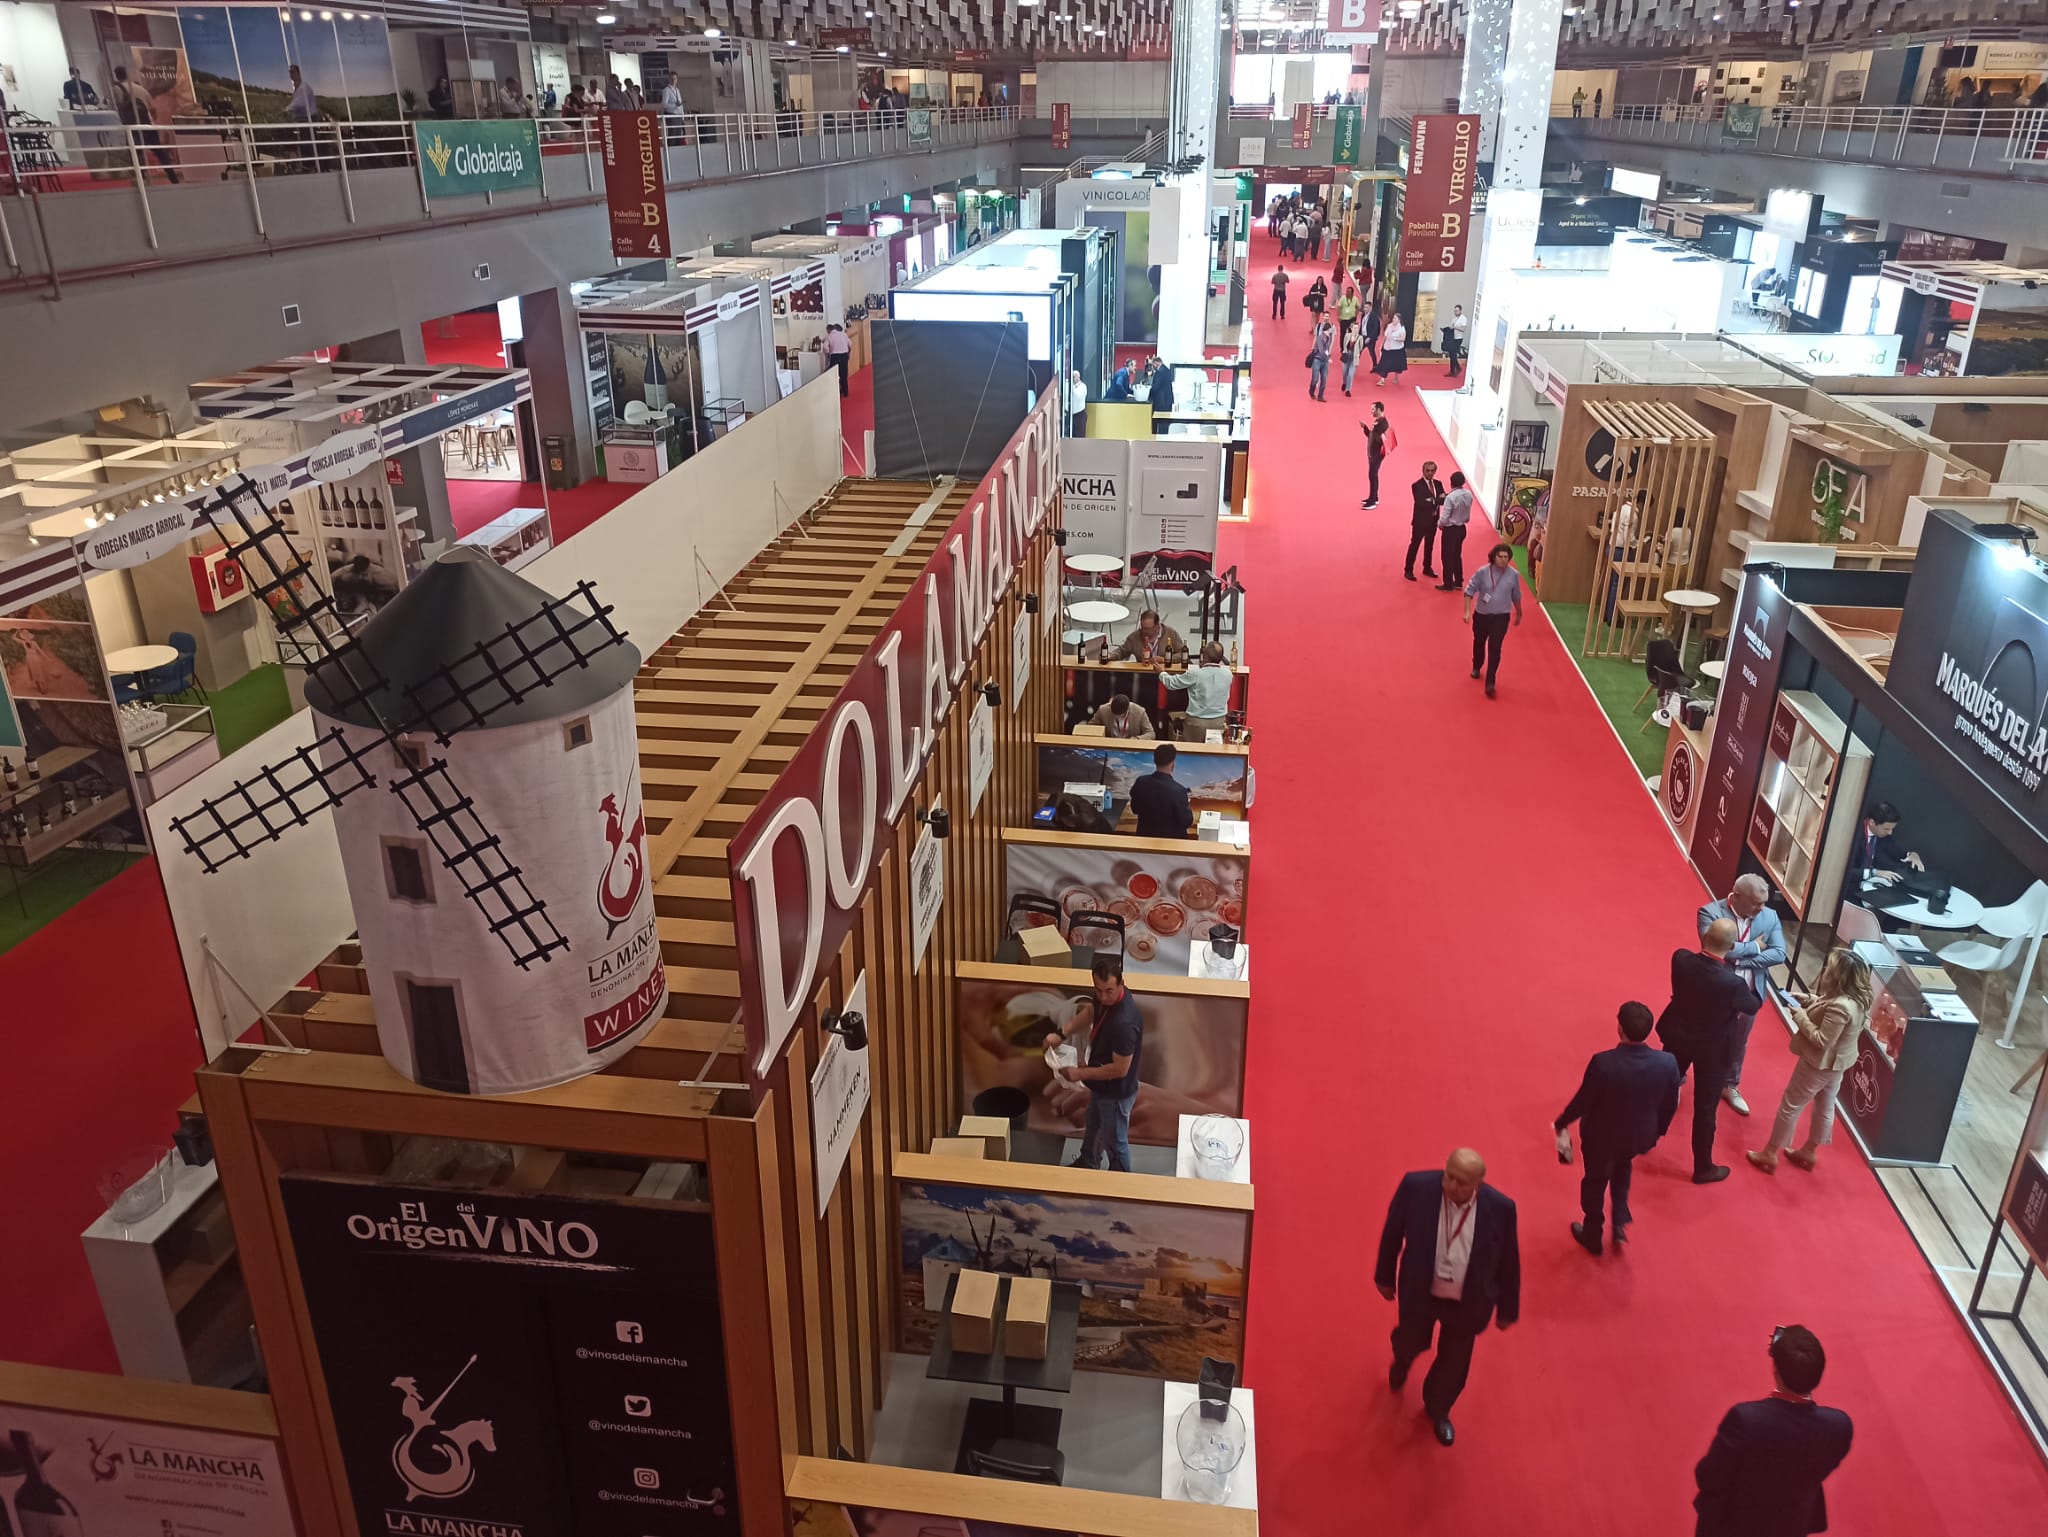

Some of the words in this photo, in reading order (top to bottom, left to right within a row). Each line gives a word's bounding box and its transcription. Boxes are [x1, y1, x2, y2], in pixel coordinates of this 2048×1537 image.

[1342, 0, 1366, 28] B
[602, 115, 616, 166] FENAVIN
[1344, 109, 1355, 149] Globalcaja
[637, 115, 657, 194] VIRGILIO
[1413, 120, 1427, 175] FENAVIN
[455, 143, 524, 178] Globalcaja
[1449, 120, 1472, 206] VIRGILIO
[641, 202, 660, 226] B
[1408, 222, 1440, 231] Pabellón
[1440, 213, 1461, 239] B
[617, 237, 633, 245] Calle
[648, 233, 662, 254] 4
[1407, 229, 1437, 238] Pavilion
[1405, 251, 1424, 259] Calle
[1405, 259, 1423, 267] Aisle
[1440, 246, 1457, 268] 5
[311, 456, 334, 473] CONCEJO
[333, 446, 355, 465] BODEGAS
[269, 473, 288, 490] MATEOS
[1071, 503, 1082, 511] DE
[1084, 504, 1117, 512] ORIGEN
[93, 534, 129, 560] BODEGAS
[128, 522, 156, 546] MAIRES
[155, 512, 186, 536] ARROCAL
[1935, 651, 2004, 732] MARQUÉS
[2000, 708, 2030, 758] DEL
[740, 700, 877, 1081] DO
[877, 573, 952, 828] LA
[948, 388, 1062, 687] MANCHA
[1954, 713, 1974, 737] grupo
[1971, 723, 2004, 763] bodeguero
[2002, 751, 2023, 778] desde
[2022, 766, 2042, 793] 1899
[588, 962, 613, 984] LA
[593, 959, 666, 1037] WINES
[827, 1065, 861, 1153] HAMMEKEN
[399, 1202, 428, 1223] El
[456, 1202, 475, 1214] del
[346, 1214, 469, 1249] Origen
[458, 1212, 599, 1259] VINO
[576, 1347, 689, 1368] @vinosdelamancha
[588, 1419, 693, 1440] @vinodelamancha
[128, 1447, 157, 1468] LA
[162, 1452, 265, 1482] MANCHA
[216, 1481, 229, 1489] DE
[231, 1483, 269, 1497] ORIGEN
[598, 1489, 700, 1511] @vinodelamancha
[385, 1512, 416, 1532] LA
